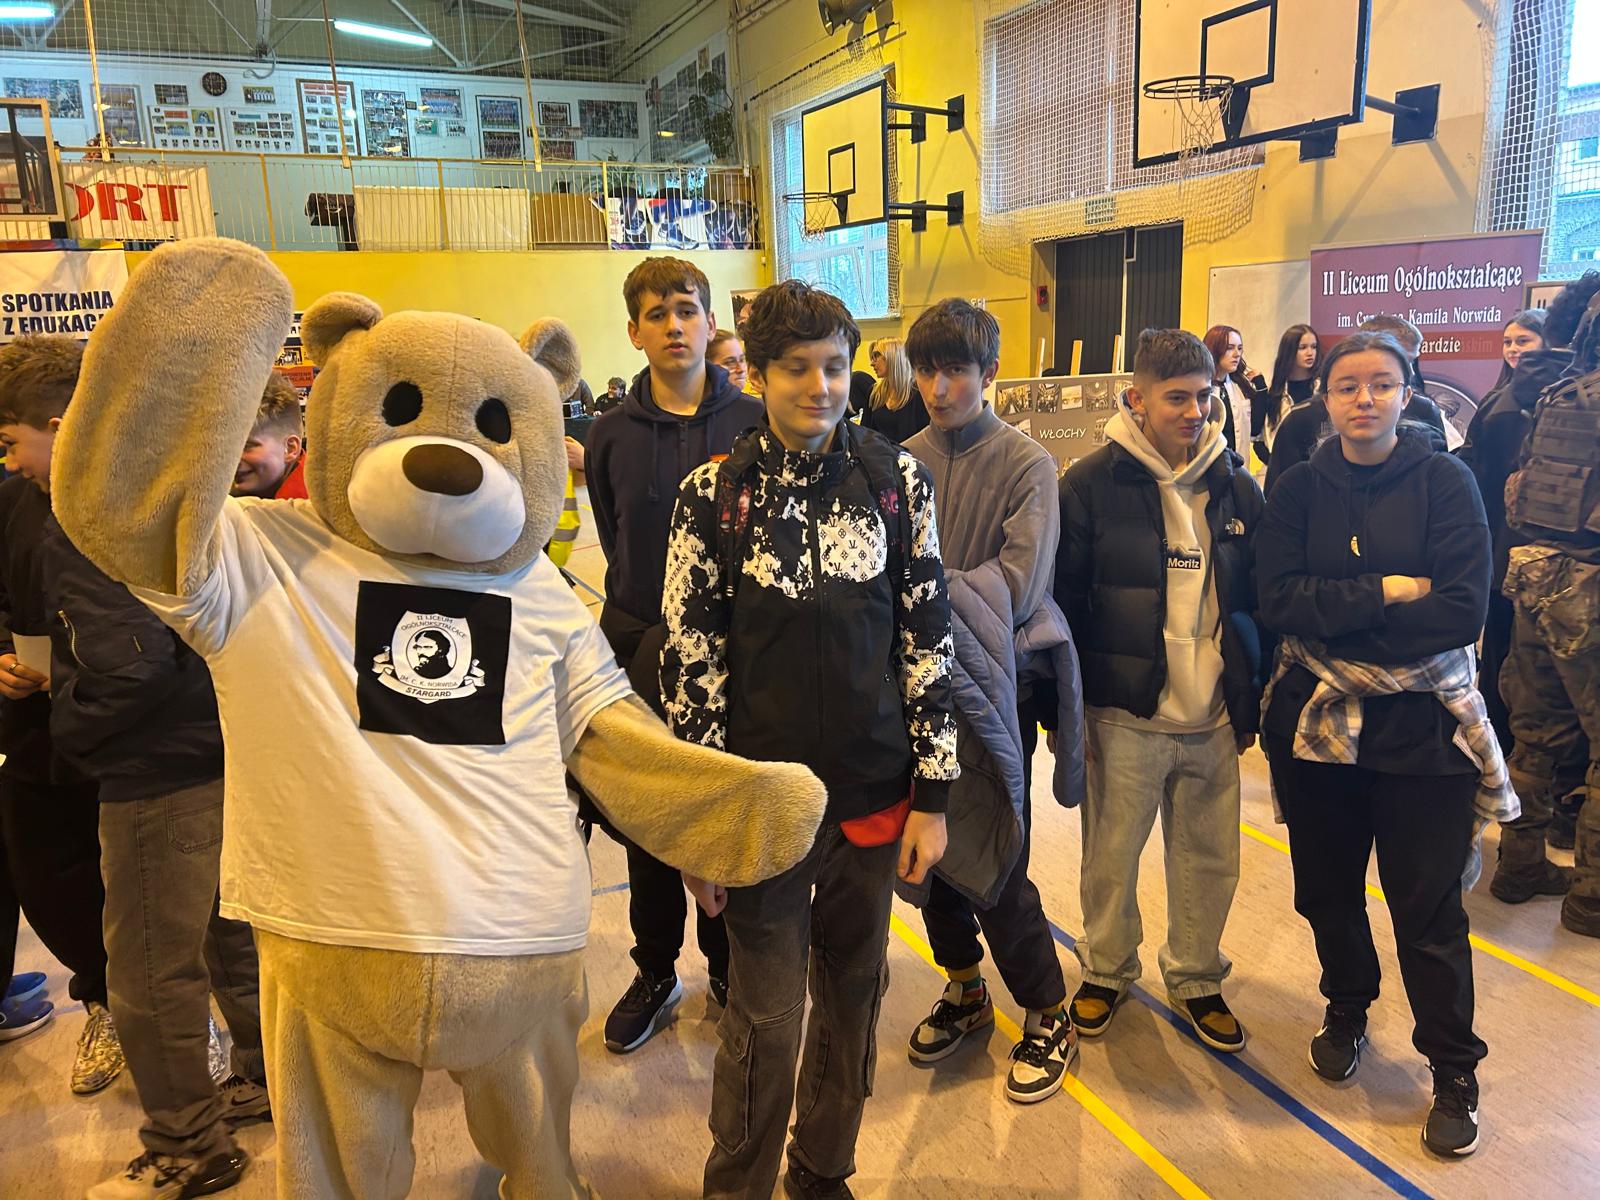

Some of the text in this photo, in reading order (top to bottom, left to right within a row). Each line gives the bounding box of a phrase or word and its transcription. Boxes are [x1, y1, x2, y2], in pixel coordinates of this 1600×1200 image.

[1323, 261, 1522, 298] II Liceum Ogólnokształcące
[1, 290, 114, 313] SPOTKANIA
[3, 313, 104, 336] Z EDUKAC
[1338, 312, 1353, 328] im.
[1408, 308, 1449, 327] Kamila
[1452, 305, 1502, 324] Norwida
[1420, 336, 1461, 354] ardzie
[1039, 427, 1087, 440] WŁOCHY
[1167, 557, 1200, 569] Moritz
[405, 686, 452, 698] STARGARD
